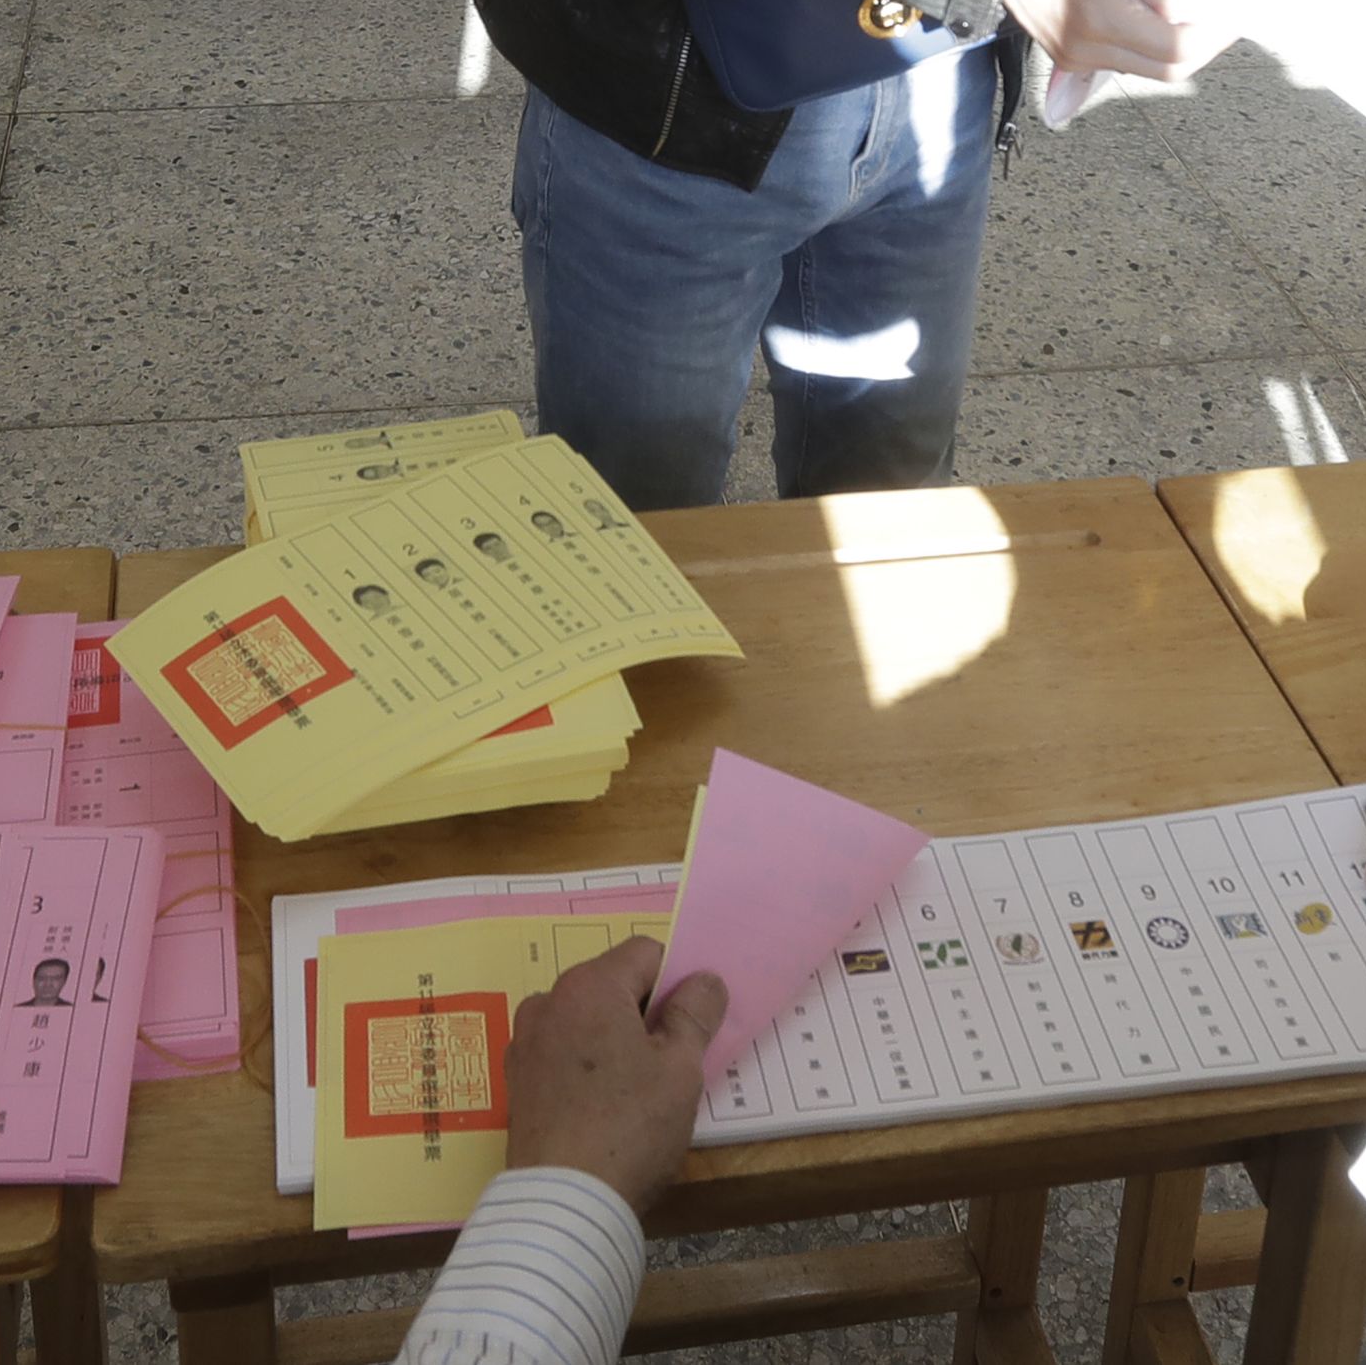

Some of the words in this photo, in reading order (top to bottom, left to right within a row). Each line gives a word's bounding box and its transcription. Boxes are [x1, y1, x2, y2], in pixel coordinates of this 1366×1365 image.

[460, 517, 476, 531] 3
[402, 543, 419, 557] 2
[1207, 877, 1236, 894] 10
[1280, 869, 1306, 887] 11
[1068, 891, 1084, 907] 8
[1141, 884, 1156, 901] 9
[920, 904, 936, 921] 6
[993, 897, 1008, 914] 7
[1179, 966, 1231, 1057] 中國國民黨
[950, 988, 993, 1082] 民主進步黨
[21, 1013, 50, 1078] 趙少康
